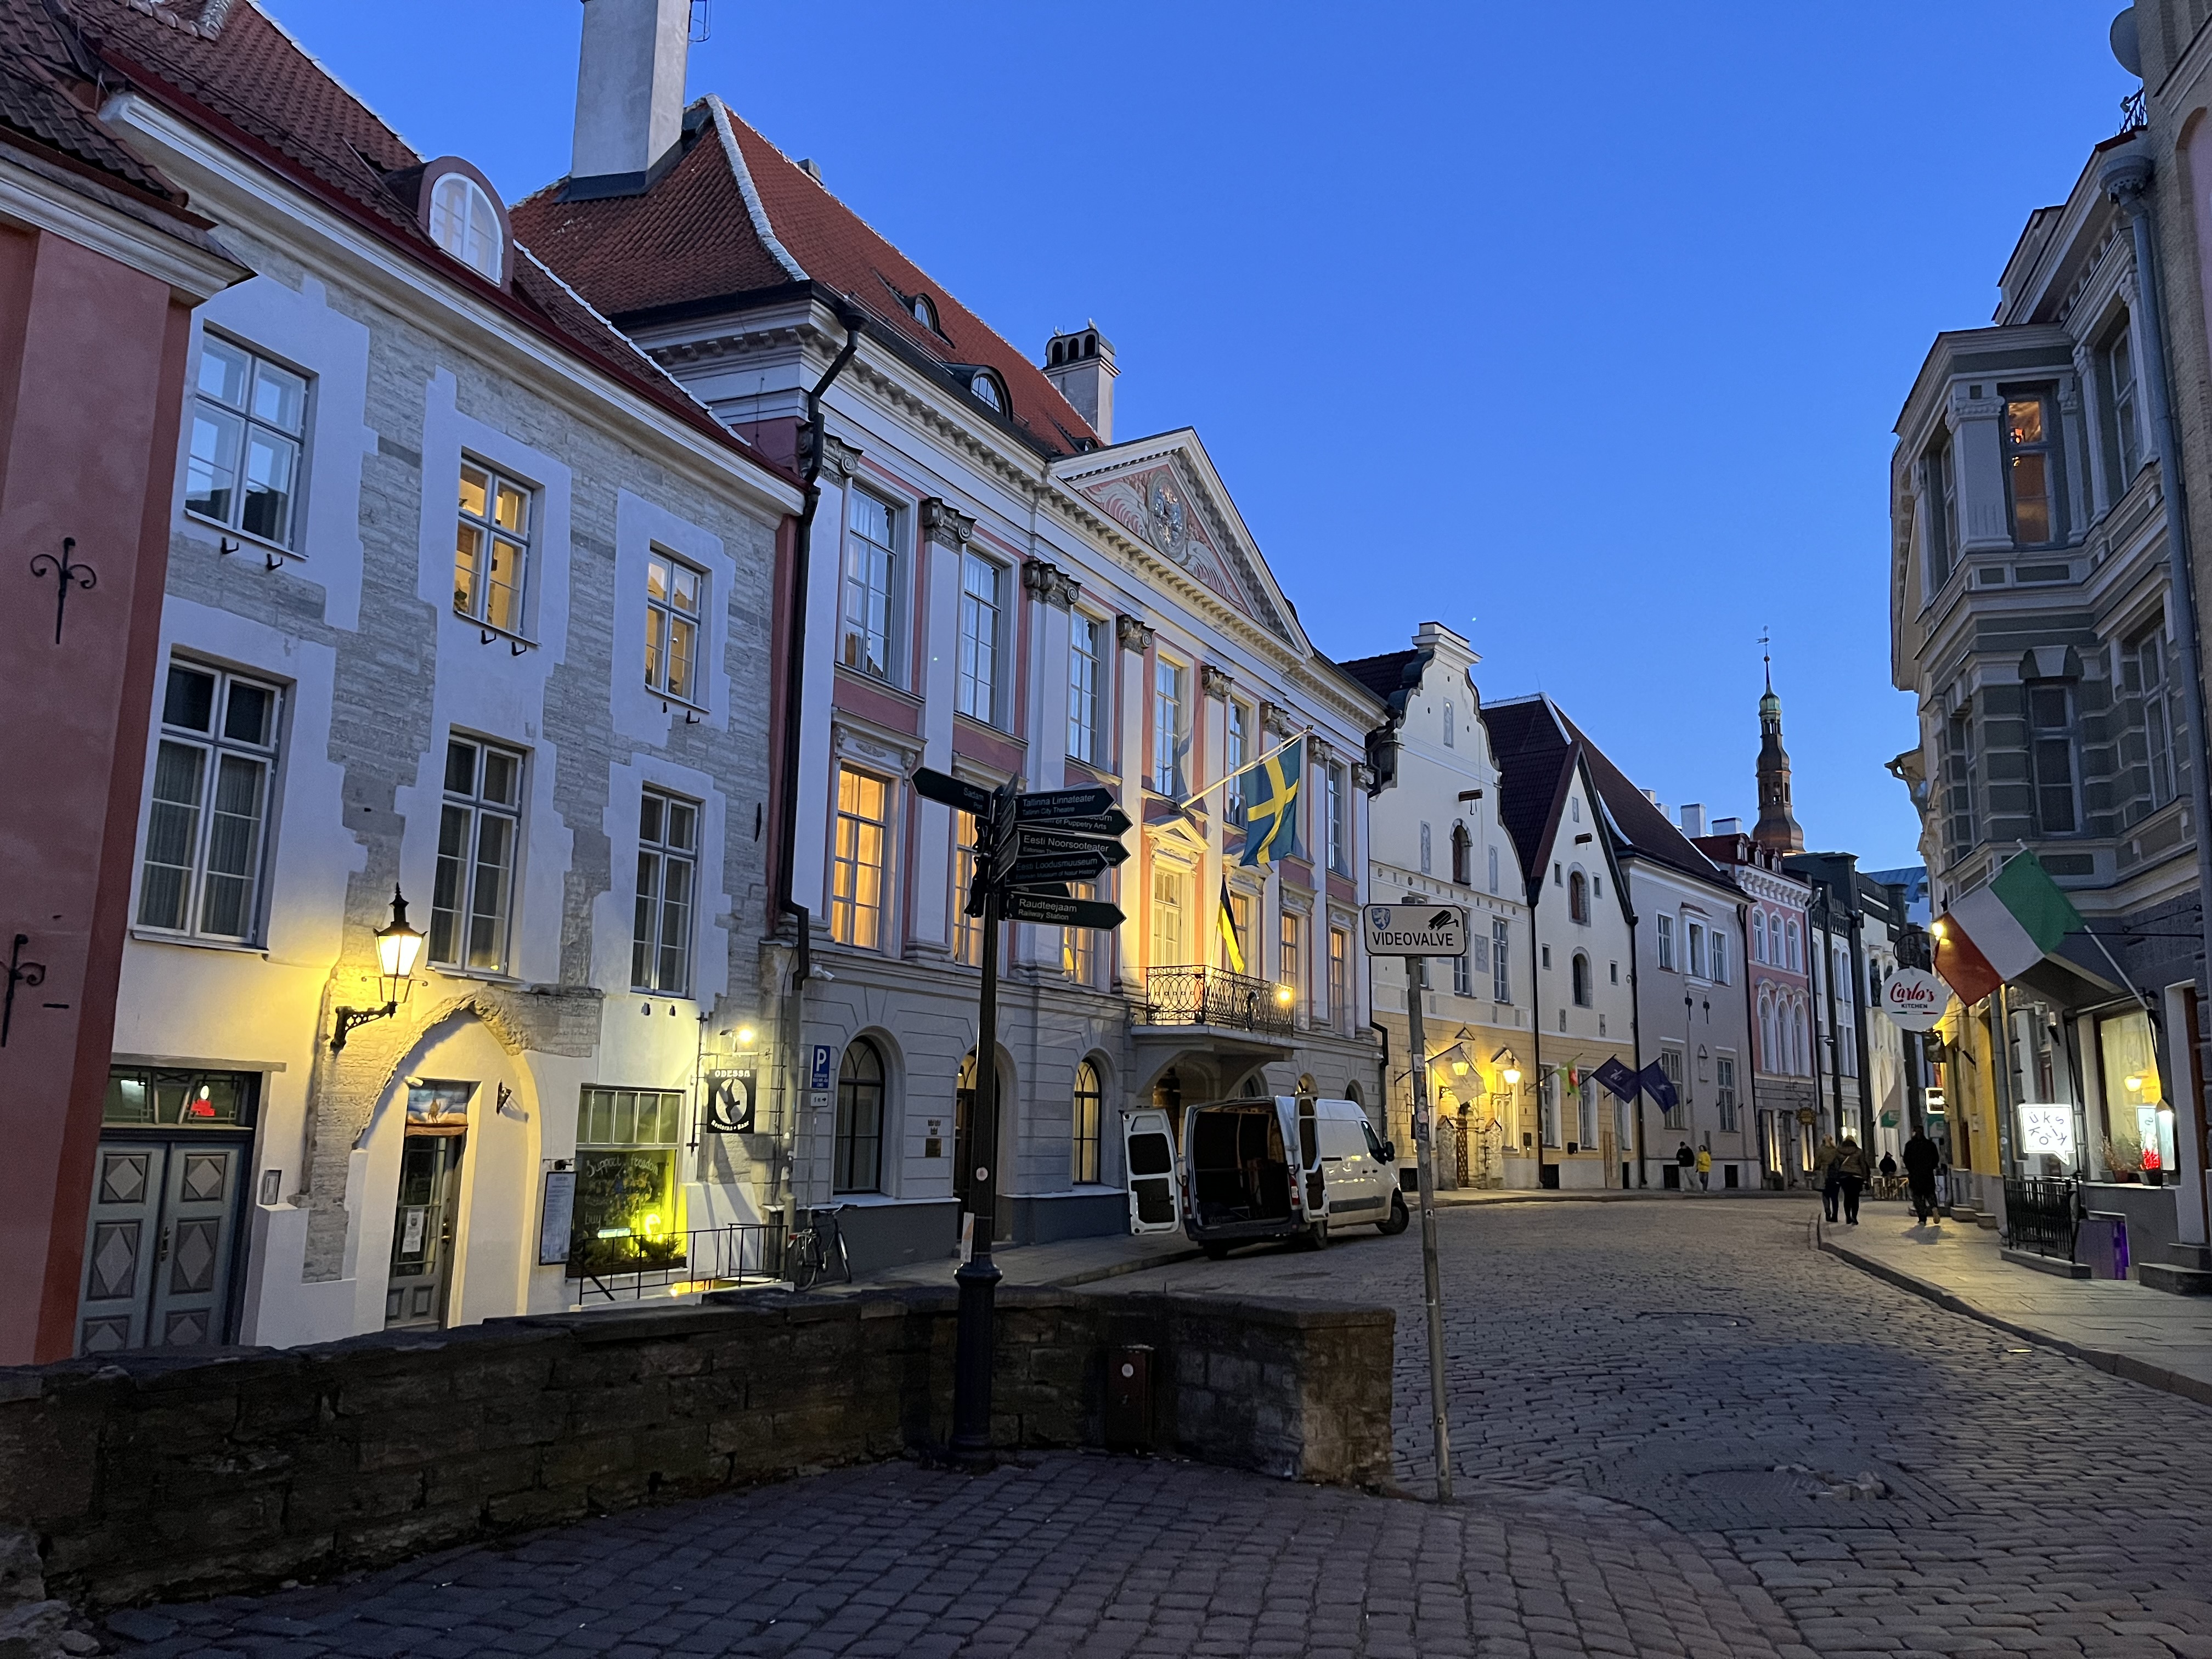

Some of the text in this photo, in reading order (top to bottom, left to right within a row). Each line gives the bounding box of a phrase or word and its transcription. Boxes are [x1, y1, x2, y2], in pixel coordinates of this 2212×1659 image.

[1022, 794, 1096, 807] Tallinna Linnateater
[1063, 819, 1093, 830] Puppetry
[1024, 834, 1110, 853] Eesti Noorsooteater
[1016, 862, 1034, 871] Eesti
[1035, 858, 1098, 870] Loodusmuuseum
[1019, 898, 1077, 913] Raudteejaam
[1018, 909, 1069, 921] Railway Station
[1372, 932, 1454, 946] VIDEOVALVE
[1890, 980, 1934, 1003] Carlo's
[816, 1048, 827, 1071] P
